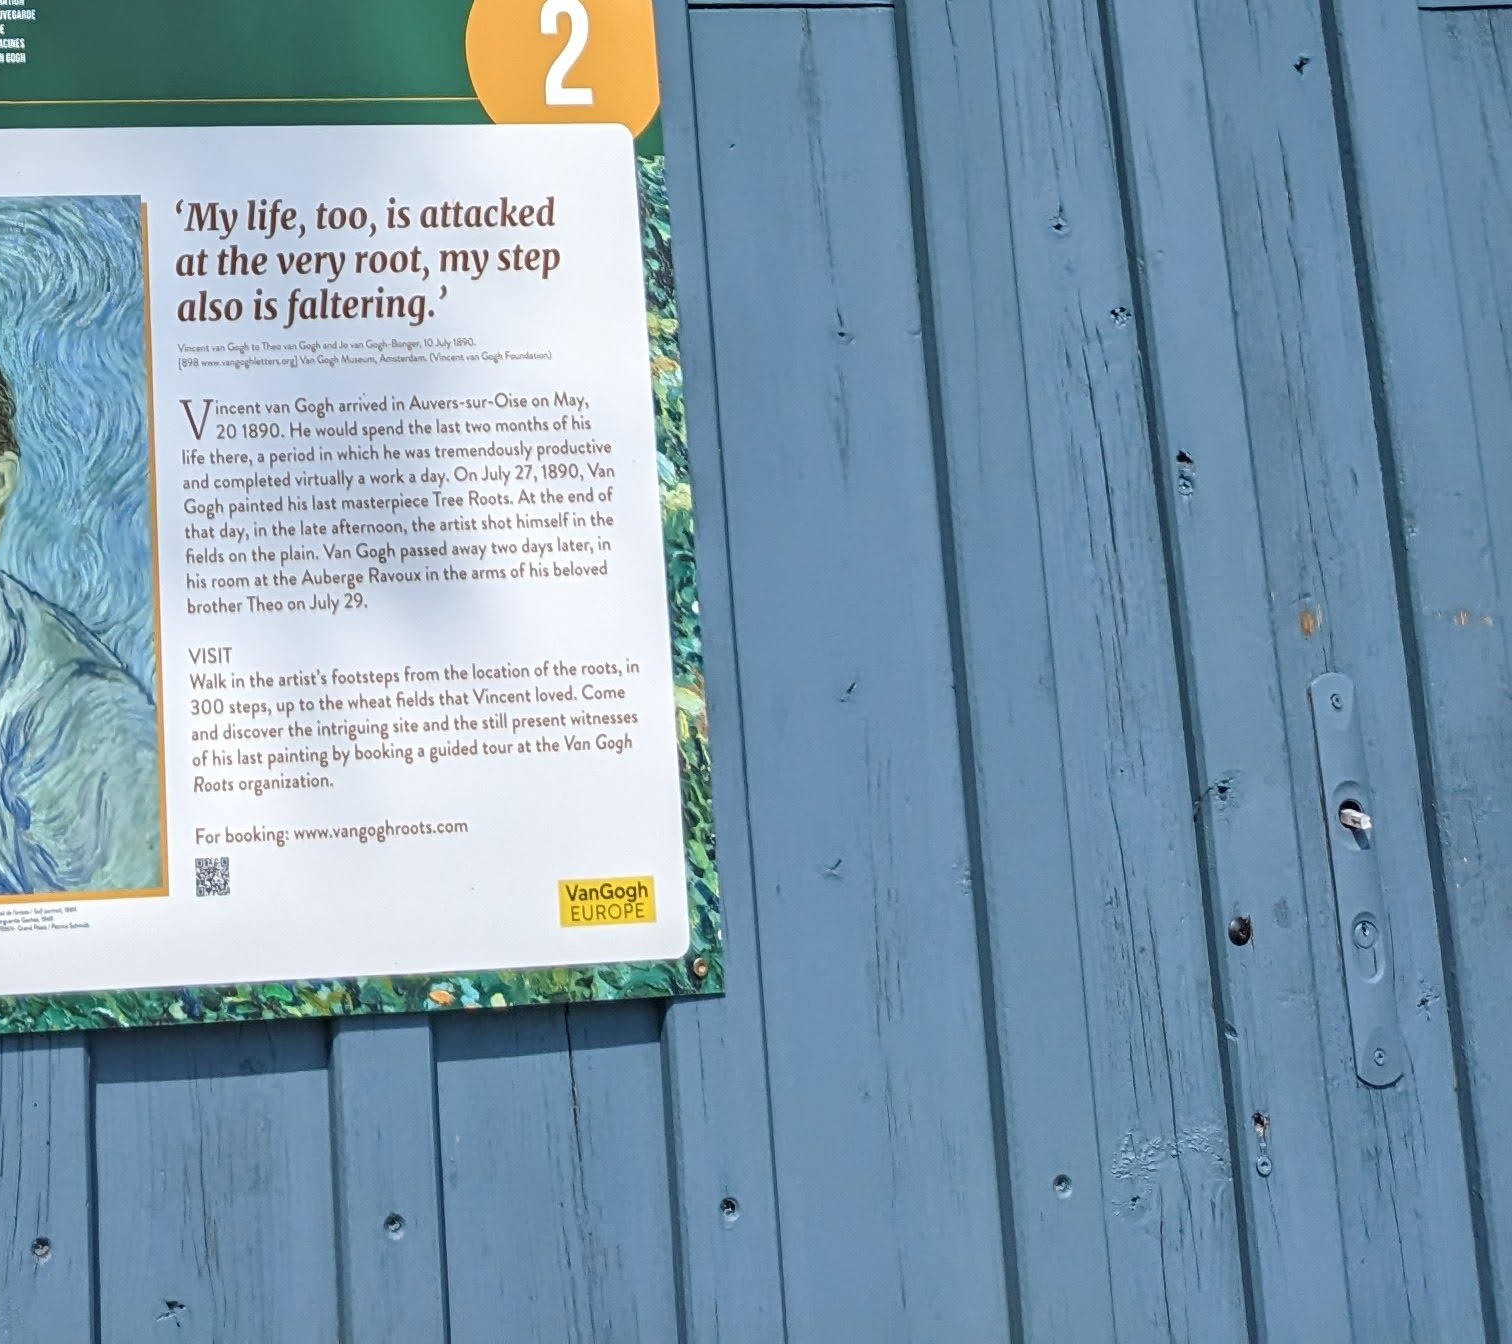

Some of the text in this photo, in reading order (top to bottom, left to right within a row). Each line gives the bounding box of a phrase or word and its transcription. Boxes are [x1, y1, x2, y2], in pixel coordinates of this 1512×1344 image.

[5, 52, 26, 64] GOGH
[247, 198, 306, 240] life,
[315, 202, 376, 238] too,
[386, 196, 410, 229] is
[419, 196, 555, 228] attacked
[175, 244, 560, 283] at the very root, my step
[177, 290, 243, 322] also
[253, 288, 278, 320] is
[179, 390, 589, 440] Vincent van Gogh arrived in Auvers-sur-Oise on May,
[183, 485, 613, 520] Gogh painted his last masterpiece Tree Roots. At the end of
[187, 646, 232, 665] VISIT
[191, 709, 638, 741] and discover the intriguing site and the still present witnesses
[195, 819, 468, 848] For booking: www.vangoghroots.com
[565, 882, 648, 902] VanGogh
[571, 904, 644, 922] EUROPE
